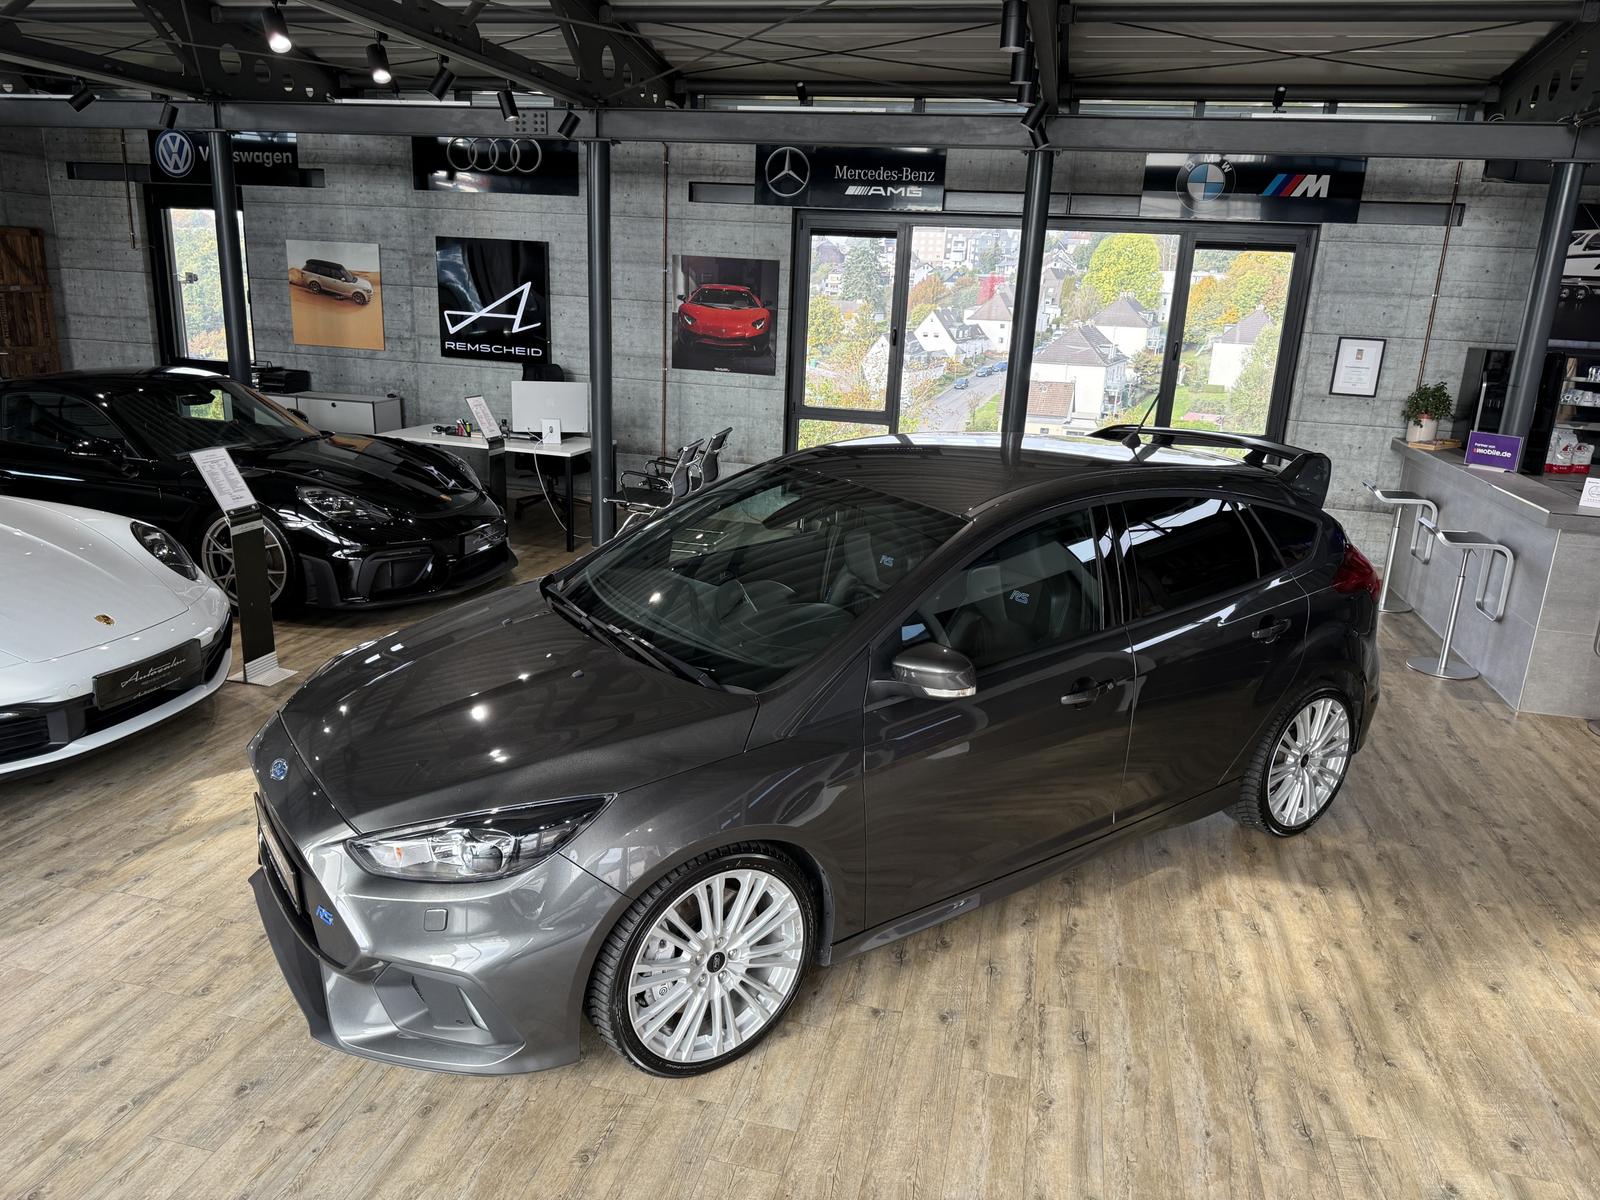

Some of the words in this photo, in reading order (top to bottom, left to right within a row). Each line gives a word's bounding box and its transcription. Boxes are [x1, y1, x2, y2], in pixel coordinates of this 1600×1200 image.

[199, 146, 293, 168] Vswagen
[834, 165, 936, 182] Mercedes-Benz
[867, 186, 923, 197] AMG
[445, 341, 543, 357] REMSCHEID
[1009, 589, 1030, 605] RS
[315, 904, 334, 927] RS
